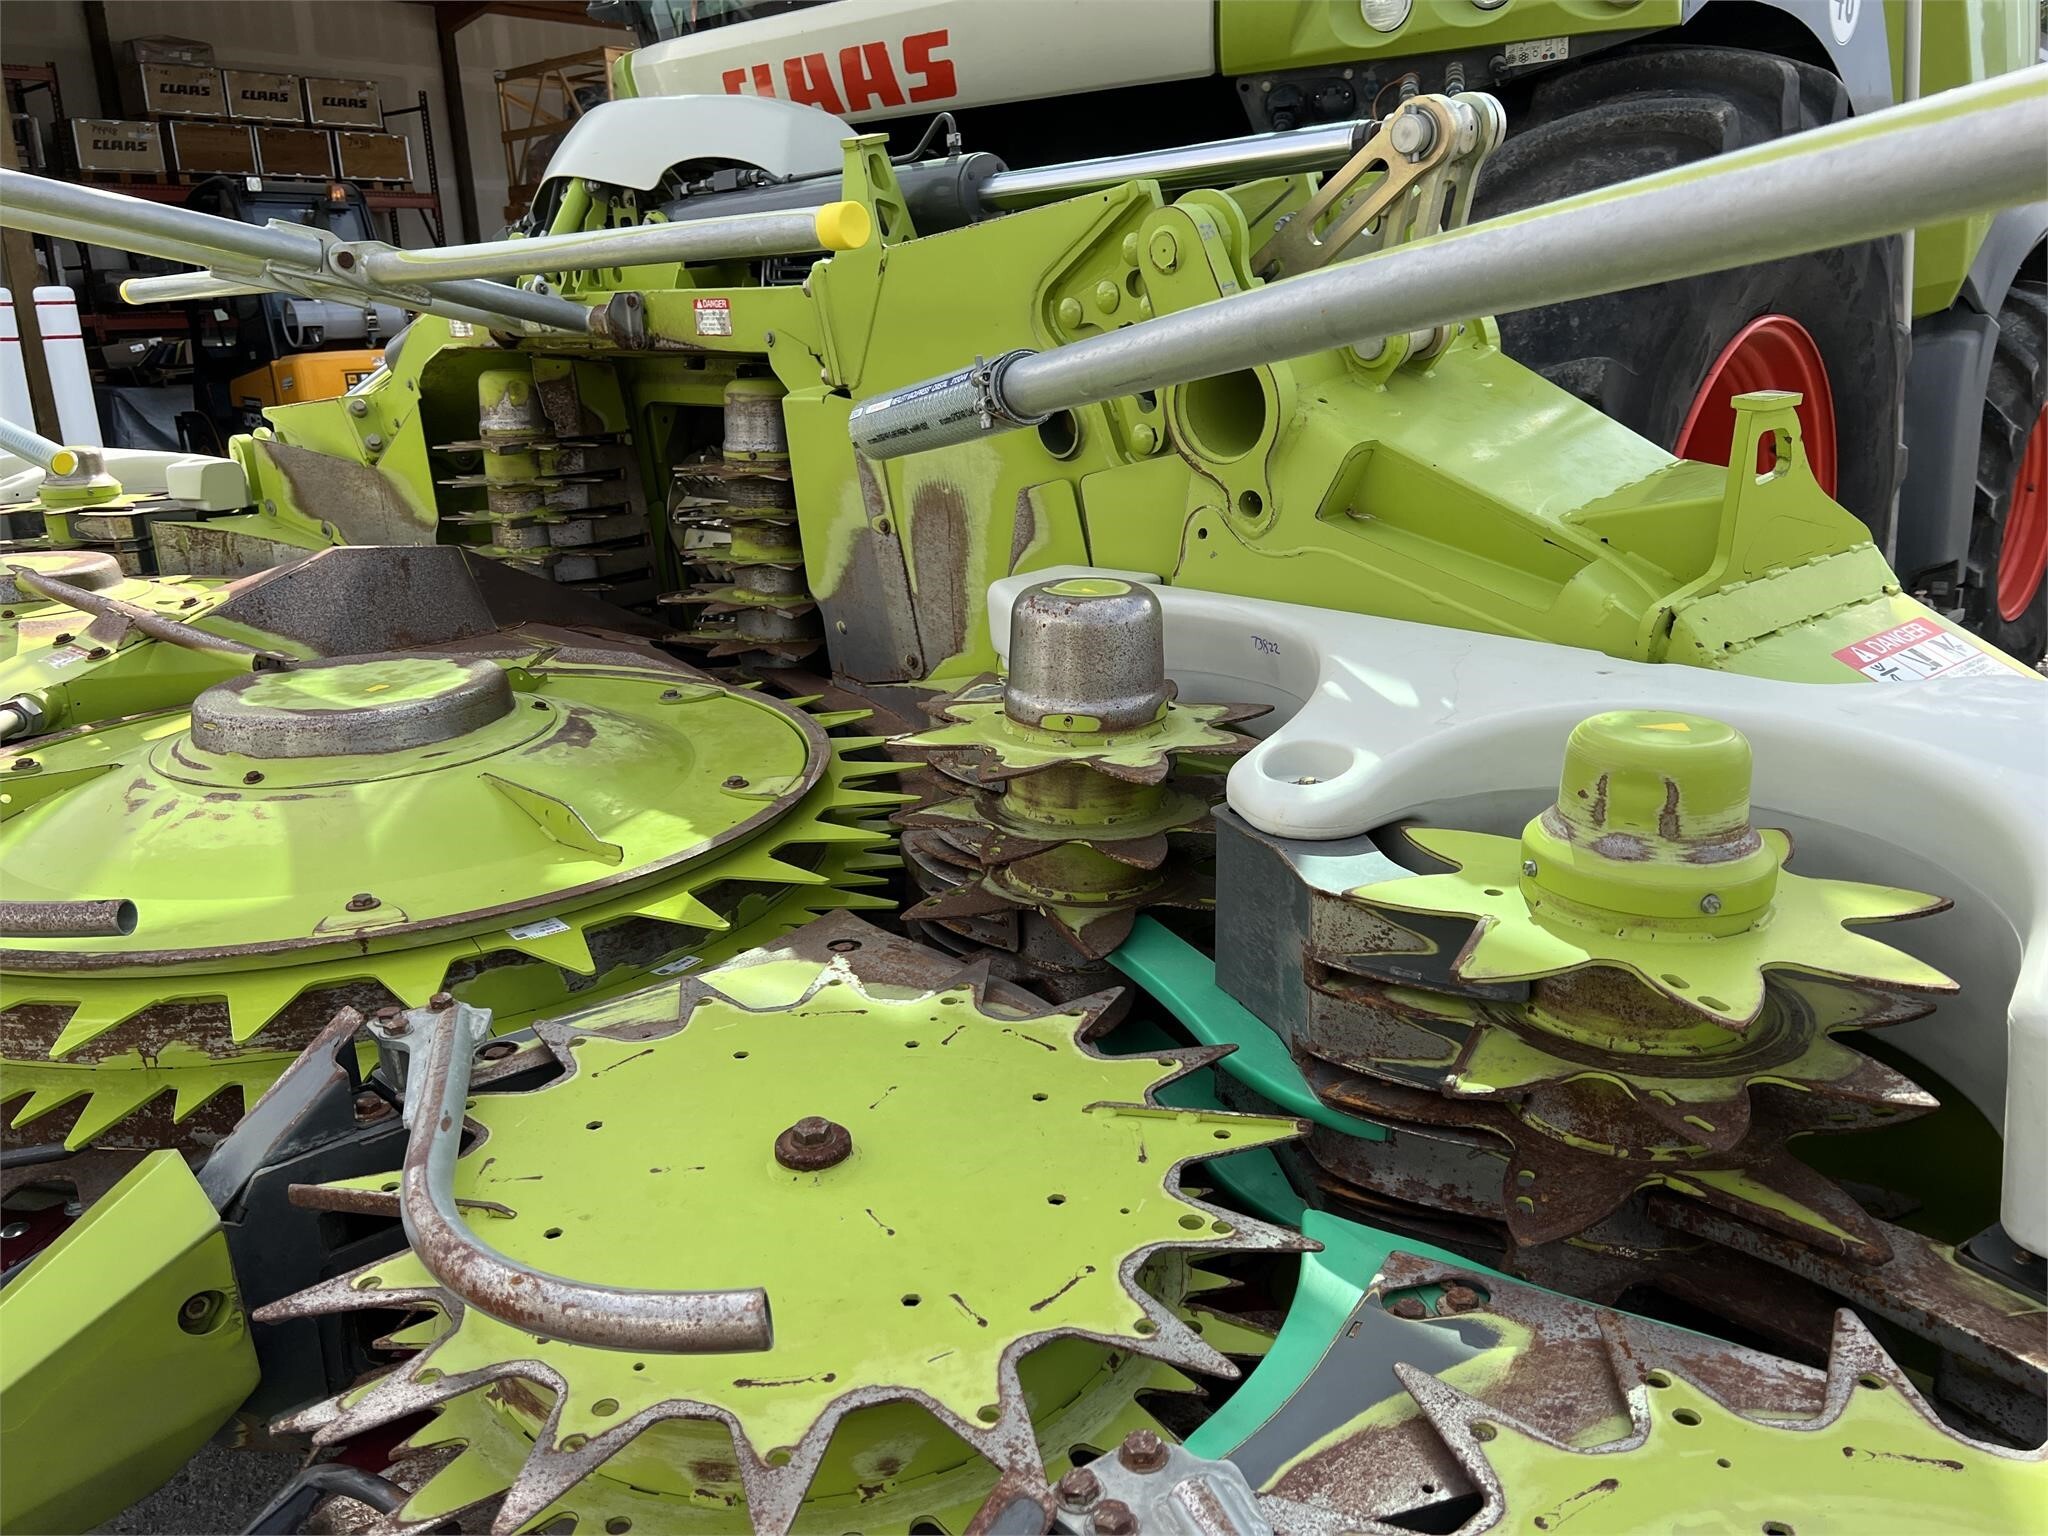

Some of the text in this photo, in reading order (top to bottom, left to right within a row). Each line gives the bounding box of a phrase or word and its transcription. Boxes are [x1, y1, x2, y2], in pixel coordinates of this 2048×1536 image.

[160, 83, 210, 96] CLAAS
[241, 89, 289, 102] CLAAS
[322, 96, 368, 108] CLAAS
[93, 139, 148, 151] CLAAS
[702, 299, 727, 308] DANGER
[243, 412, 263, 428] JCB
[1865, 622, 1932, 654] DANGER
